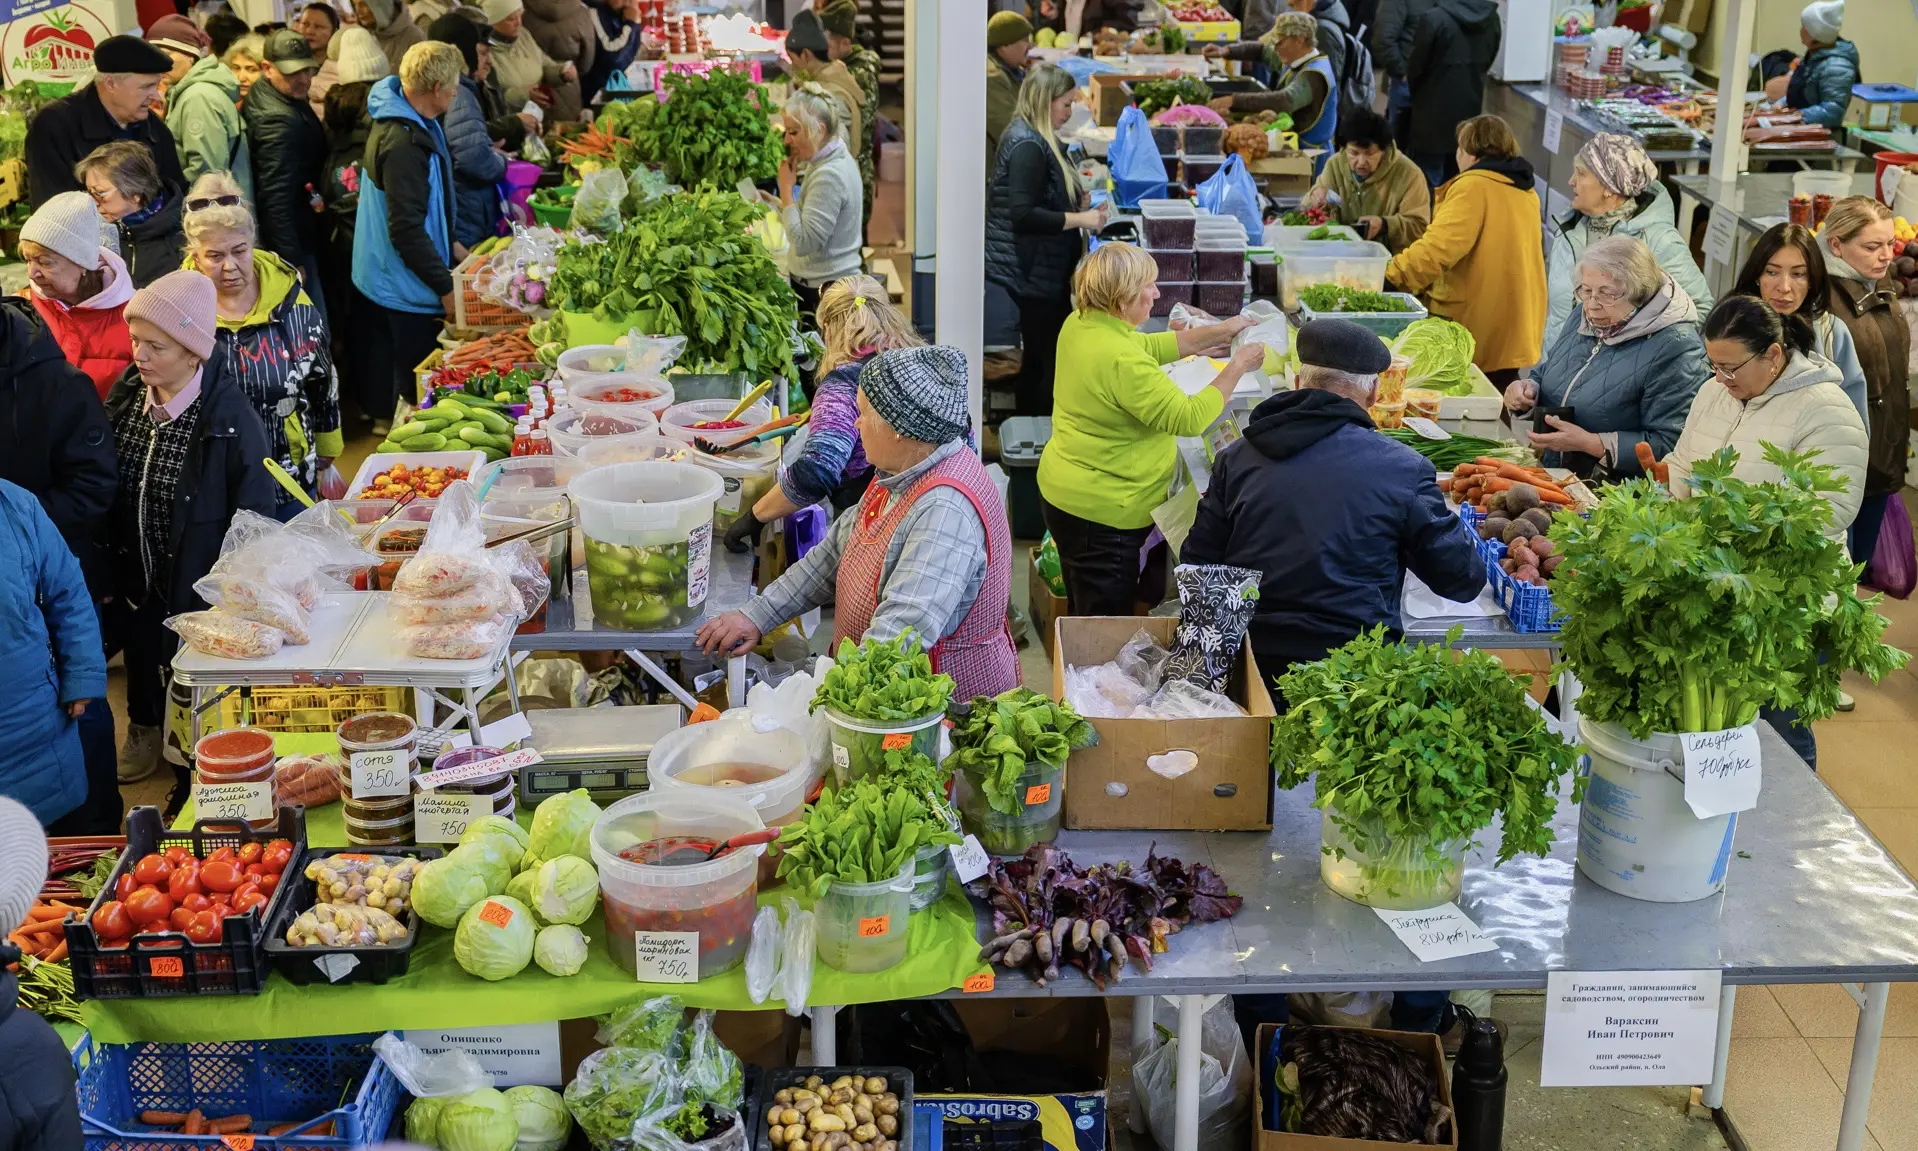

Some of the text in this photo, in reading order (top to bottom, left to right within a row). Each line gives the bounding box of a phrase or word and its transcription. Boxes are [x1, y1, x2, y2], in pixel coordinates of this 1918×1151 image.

[355, 754, 394, 769] сотэ
[418, 797, 469, 807] Малина
[440, 820, 467, 836] 750
[1572, 983, 1697, 994] Гражданин, занимающийся
[1561, 994, 1705, 1003] садоводством, огородничеством
[1604, 1016, 1659, 1027] Вараксин
[440, 1034, 502, 1044] Онищенко
[1587, 1030, 1675, 1041] Иван Петрович
[455, 1046, 541, 1057] ладимировна
[1620, 1063, 1643, 1071] район,
